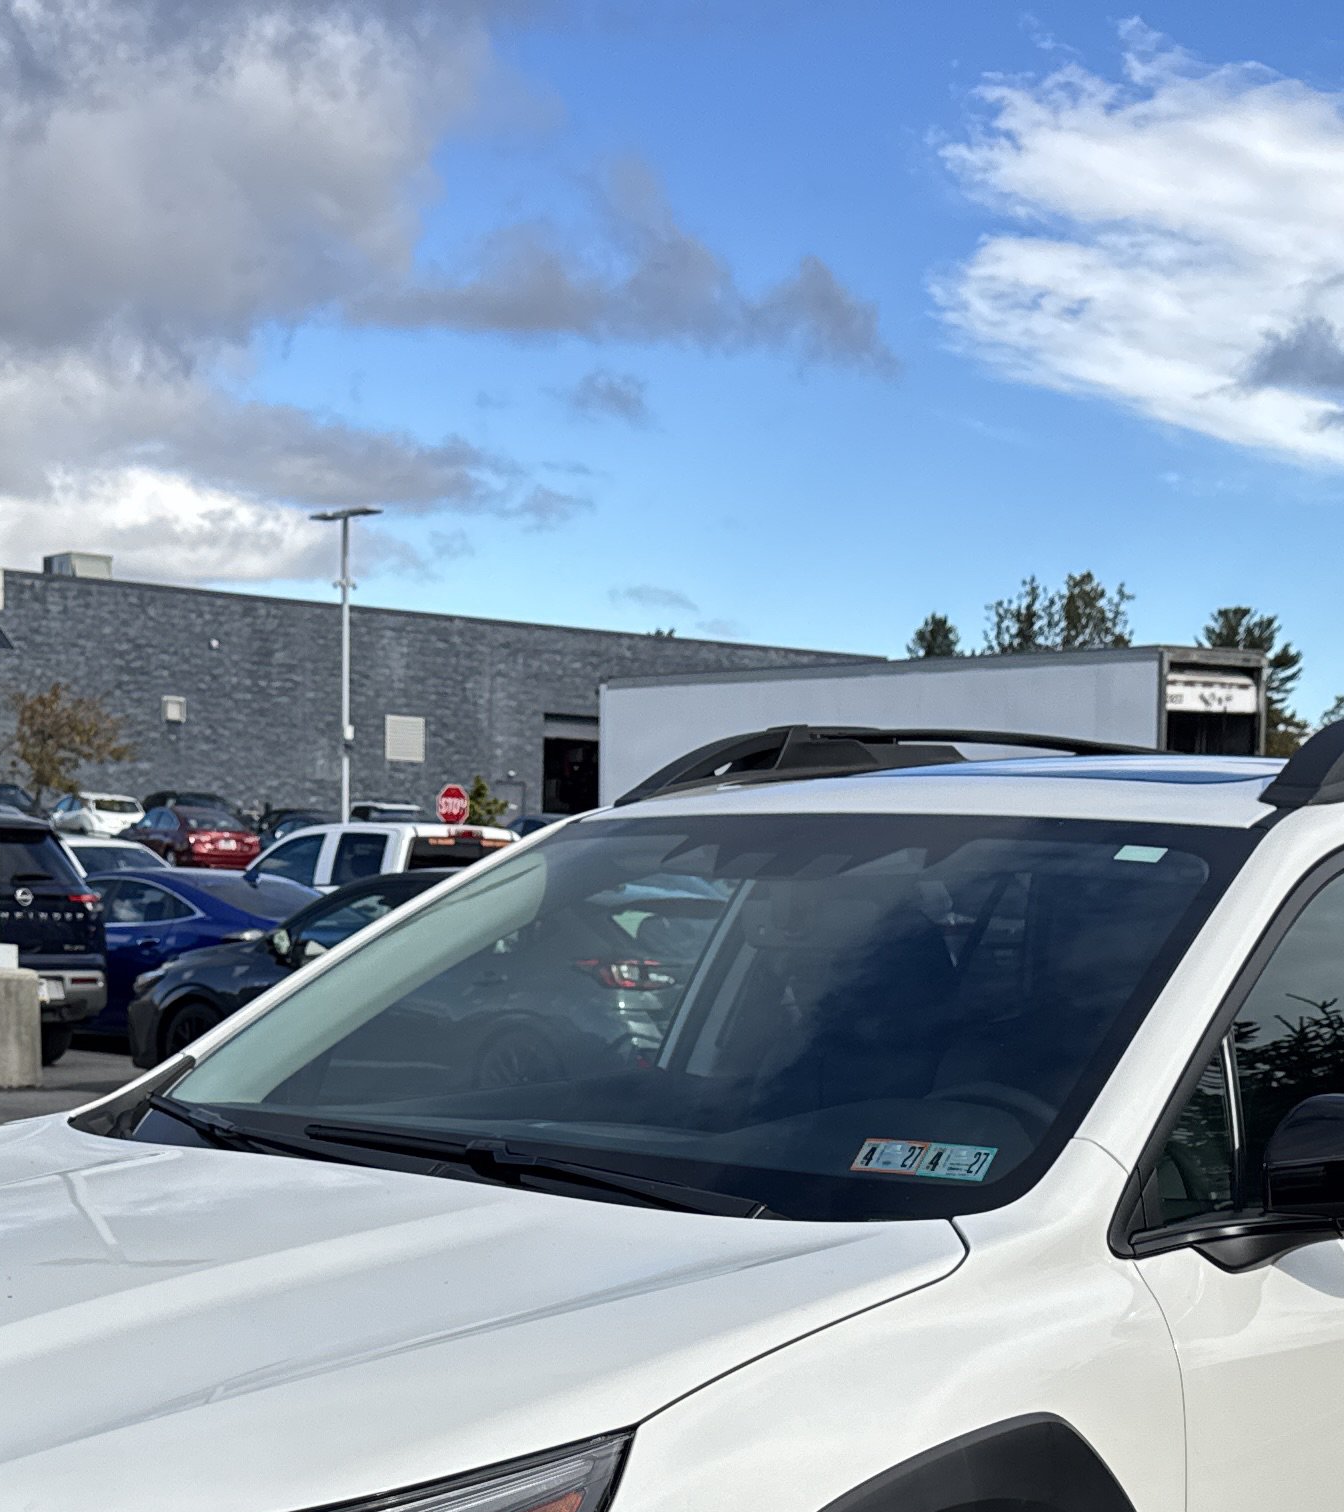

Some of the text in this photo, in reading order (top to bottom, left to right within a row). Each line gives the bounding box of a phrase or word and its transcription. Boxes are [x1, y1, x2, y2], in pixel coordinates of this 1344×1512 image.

[439, 797, 467, 814] STOP
[863, 1146, 924, 1168] 4 27
[929, 1152, 943, 1171] 4
[966, 1152, 990, 1175] 27
